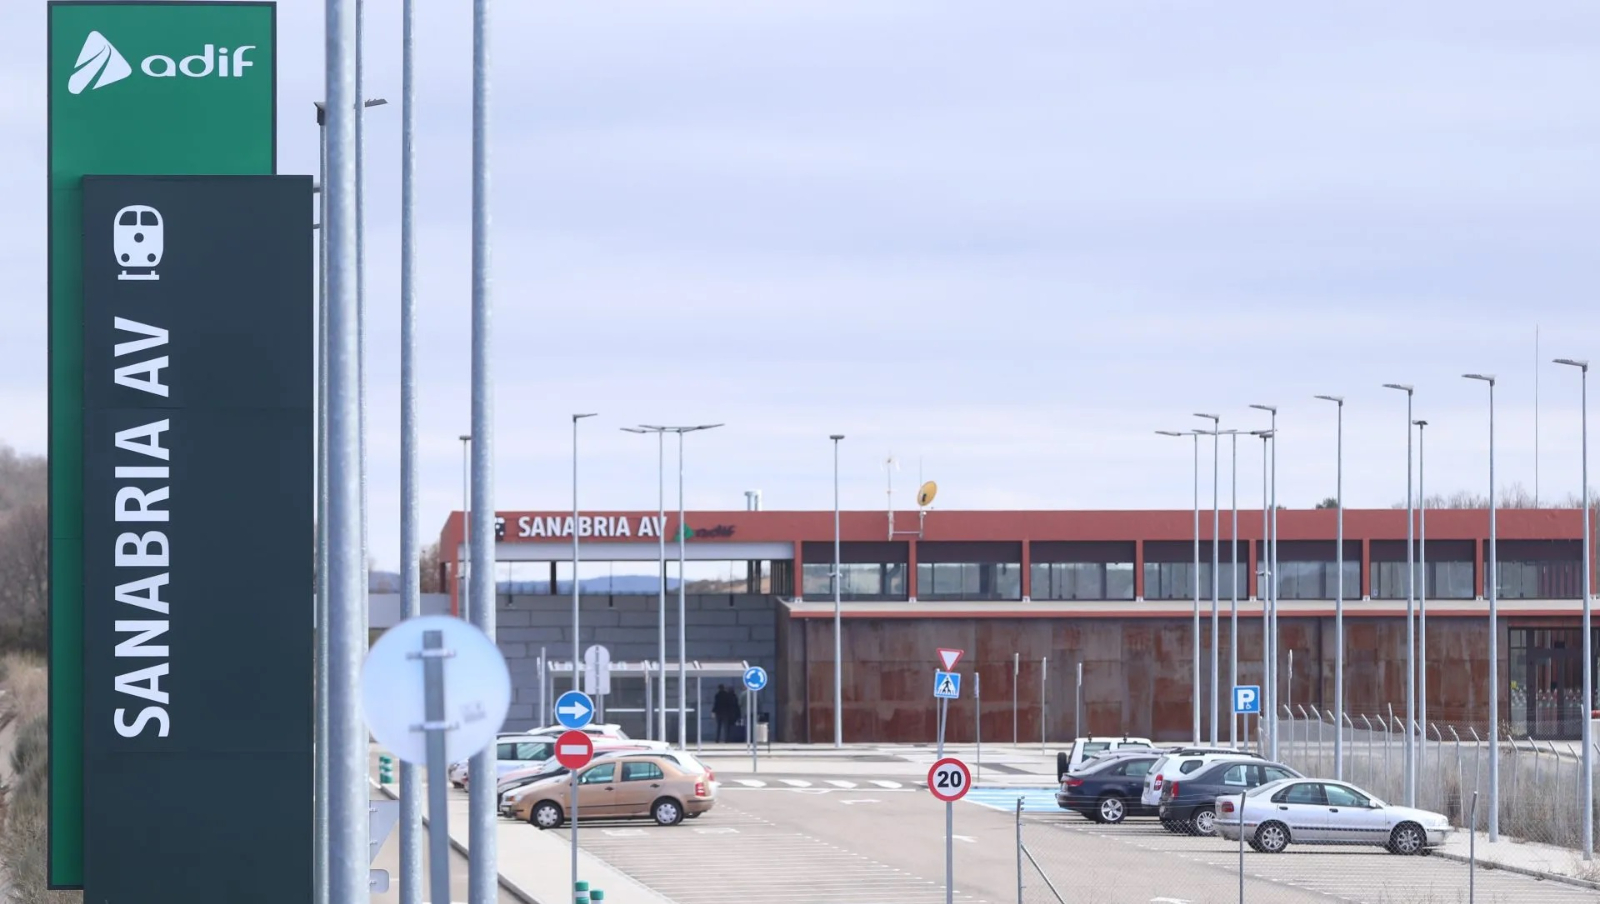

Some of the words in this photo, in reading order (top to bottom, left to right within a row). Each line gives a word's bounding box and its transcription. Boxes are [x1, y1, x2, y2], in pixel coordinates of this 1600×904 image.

[140, 43, 256, 78] adif
[114, 317, 170, 398] AV
[518, 516, 631, 538] SANABRIA
[638, 516, 667, 537] AV
[114, 418, 170, 738] SANABRIA
[1237, 689, 1255, 710] P
[937, 770, 962, 788] 20
